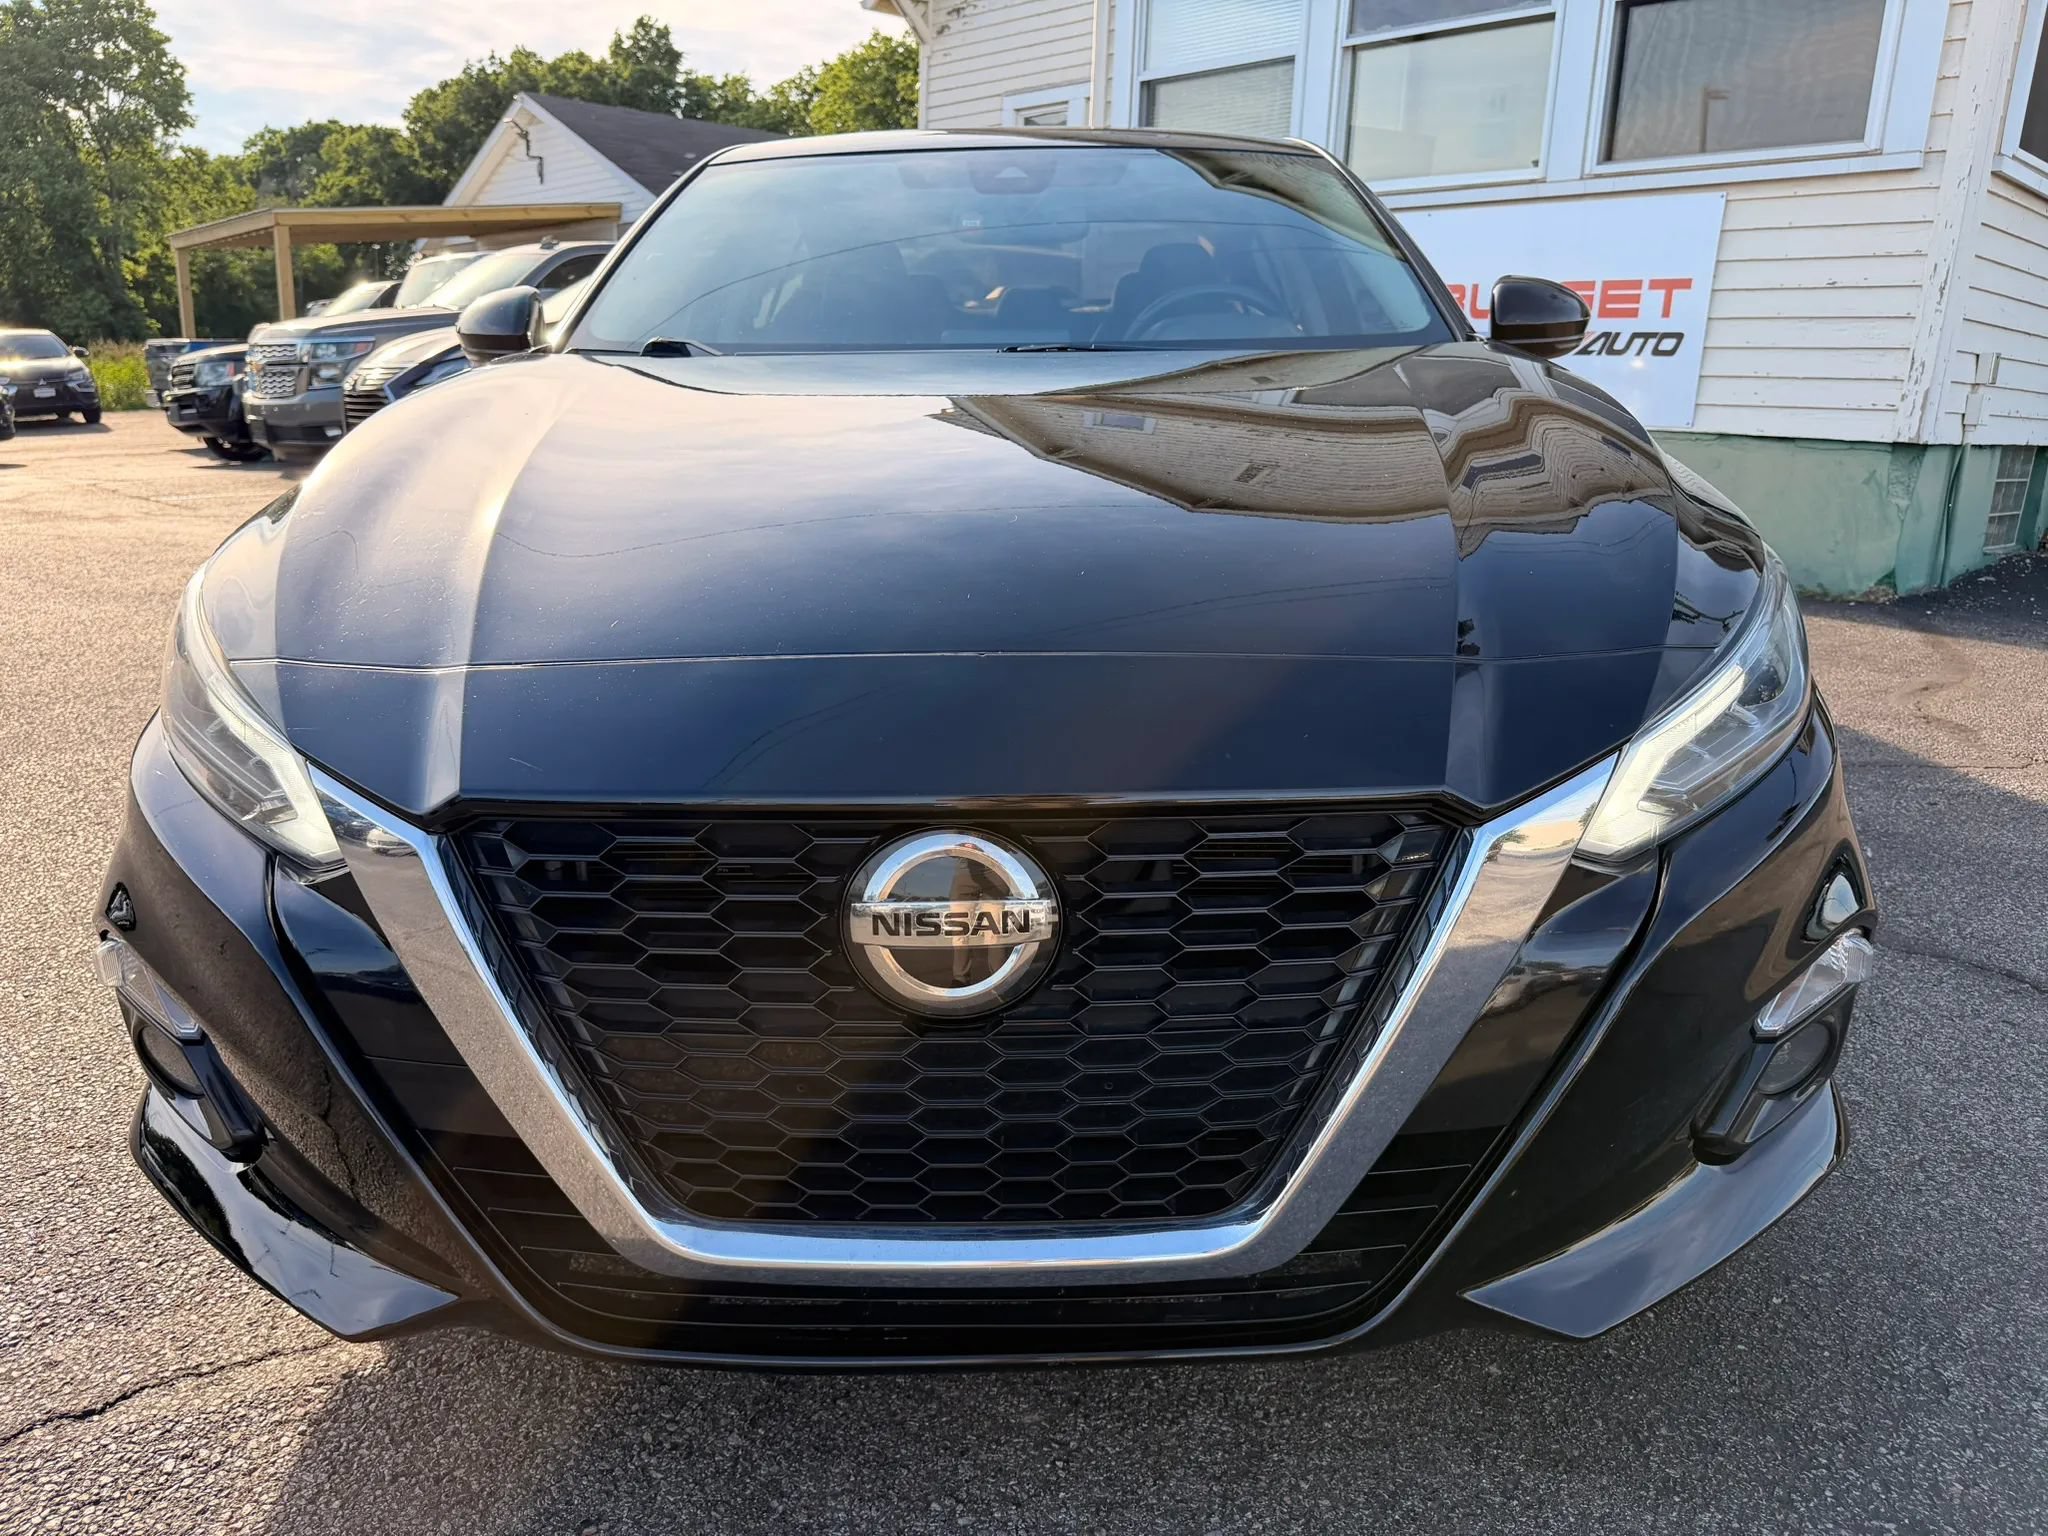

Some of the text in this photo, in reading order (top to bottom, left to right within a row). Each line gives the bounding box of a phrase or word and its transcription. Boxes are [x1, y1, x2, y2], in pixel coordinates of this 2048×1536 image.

[1447, 279, 1693, 319] UET
[1574, 332, 1685, 356] AUTO
[872, 910, 1030, 937] NISSAN
